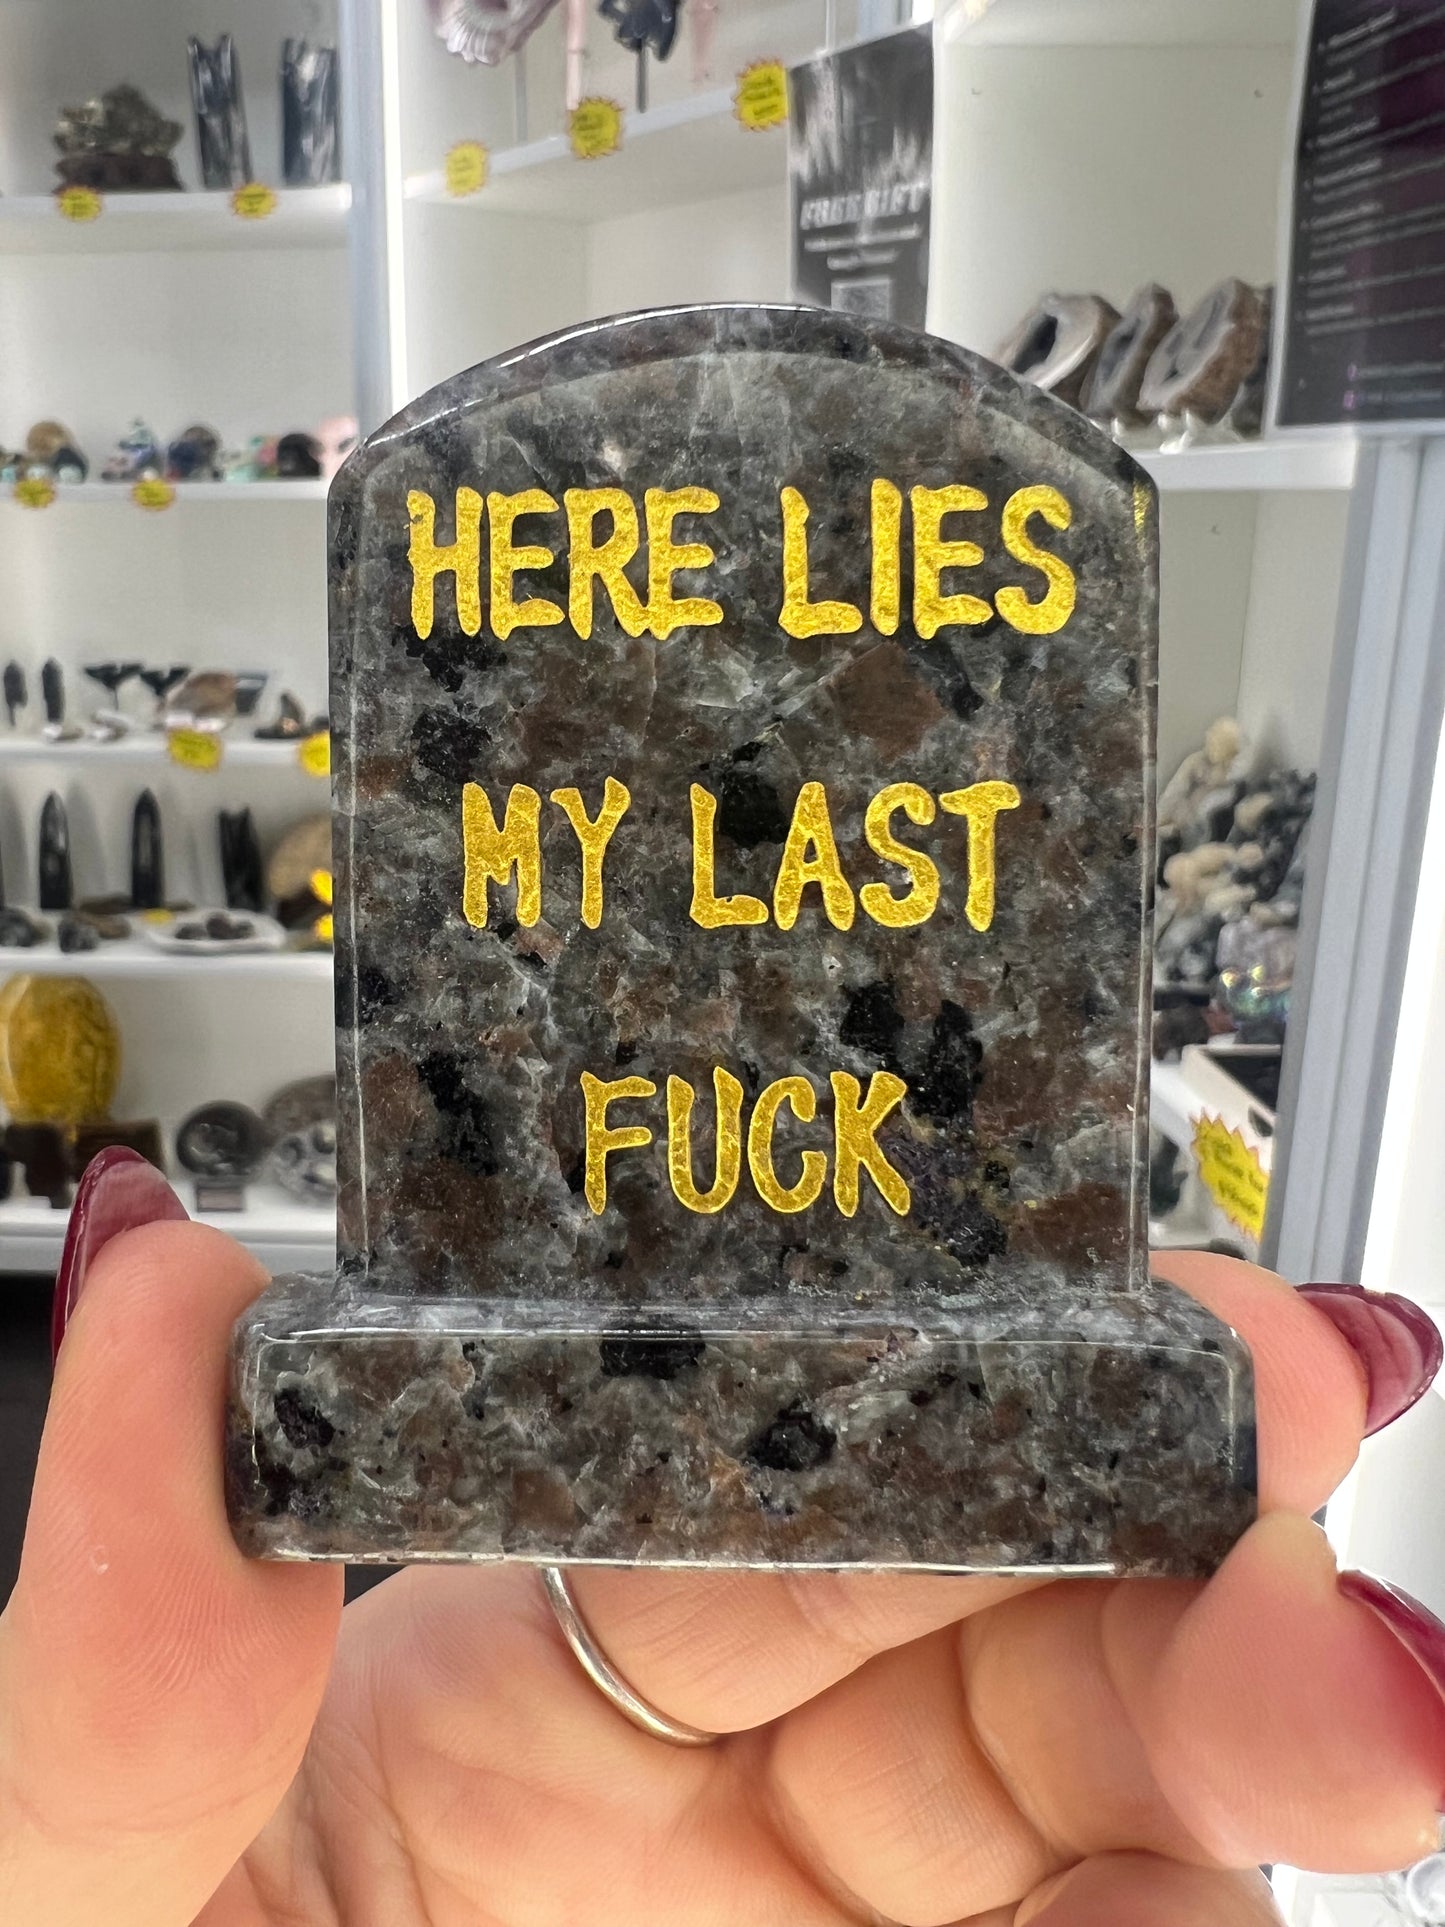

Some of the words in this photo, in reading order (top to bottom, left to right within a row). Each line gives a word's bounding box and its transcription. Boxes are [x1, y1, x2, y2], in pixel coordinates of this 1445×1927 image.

[406, 485, 724, 641] HERE
[780, 478, 1078, 638] LIES
[461, 776, 631, 930] MY
[690, 780, 1021, 932] LAST
[581, 1065, 911, 1218] FUCK
